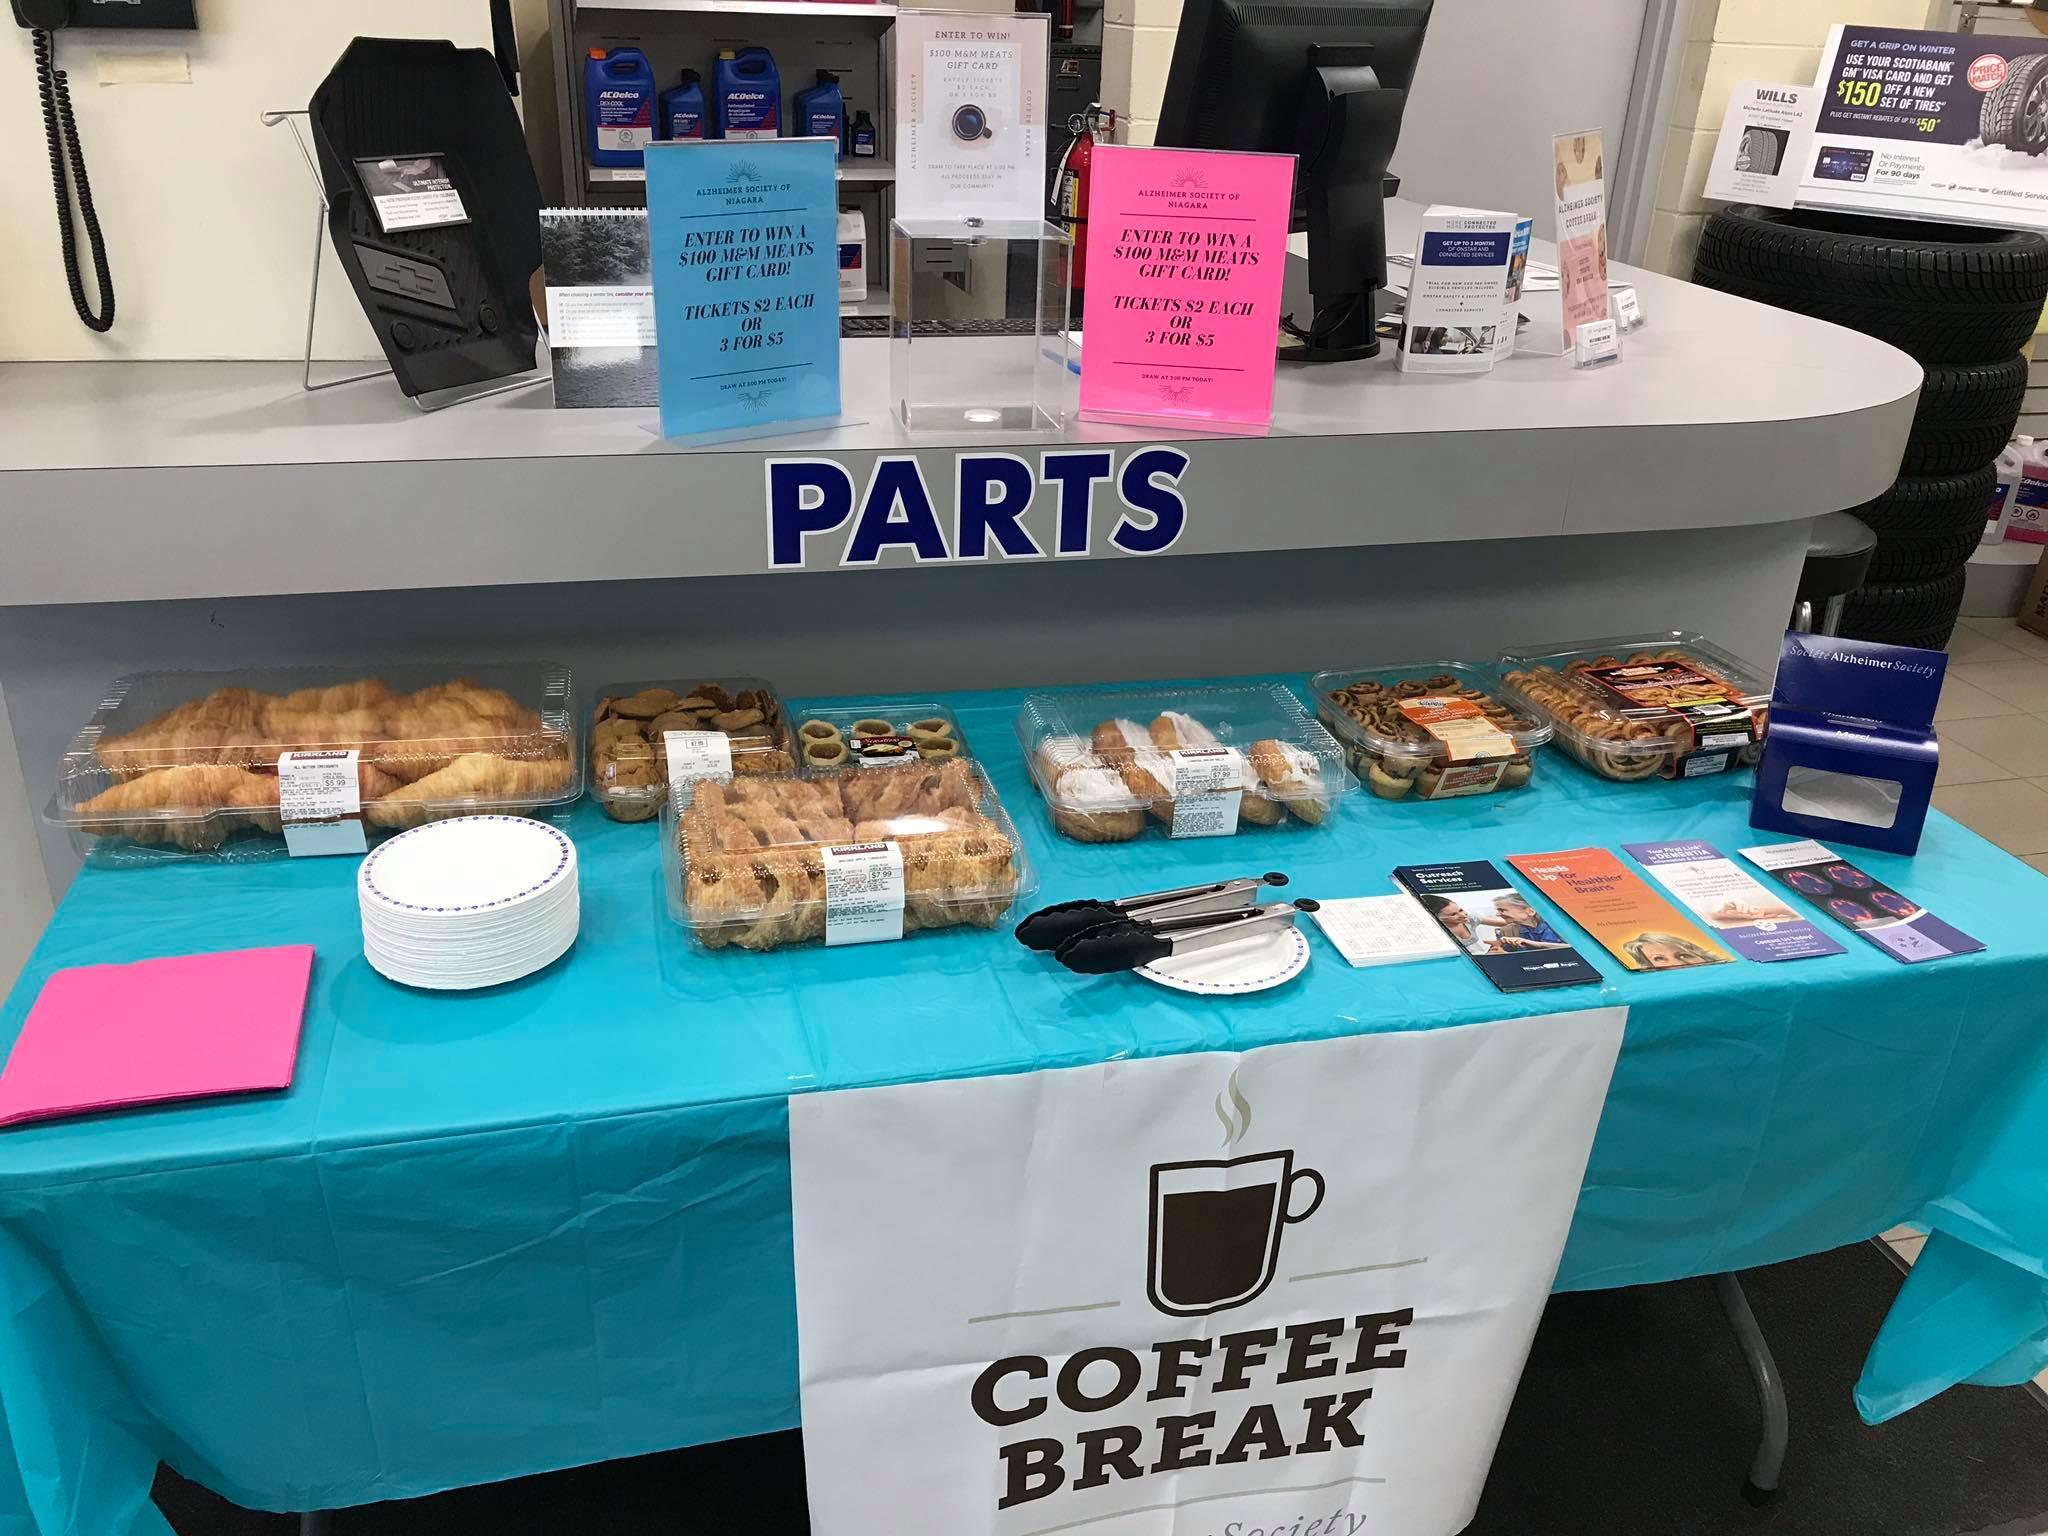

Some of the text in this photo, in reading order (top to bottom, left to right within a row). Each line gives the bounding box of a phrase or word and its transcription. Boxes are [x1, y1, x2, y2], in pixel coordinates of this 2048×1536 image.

[935, 31, 1010, 40] ENTER TO WIN!
[929, 49, 1014, 59] $100 M&M MEATS
[1851, 40, 1869, 48] GET
[1878, 42, 1901, 50] GRIP
[1919, 45, 1956, 55] WINTER
[947, 61, 999, 70] GIFT CARD
[1846, 54, 1865, 65] USE
[1866, 55, 1891, 67] YOUR
[1973, 63, 2003, 75] PRICE
[1886, 71, 1911, 82] CARD
[1912, 73, 1933, 84] AND
[1934, 75, 1954, 86] GET
[1973, 72, 2003, 83] MATCH
[600, 91, 639, 99] ACDelco
[1756, 89, 1798, 104] WILLS
[1837, 79, 1936, 107] $150 OFF A NEW
[1880, 97, 1898, 108] SET
[1899, 99, 1912, 110] OF
[1872, 114, 1893, 122] REBATES
[1893, 154, 1920, 162] Interest
[1890, 162, 1925, 172] Payments
[1903, 170, 1921, 179] days
[697, 187, 743, 196] ALZHEIMER
[745, 185, 777, 193] SOCIETY
[1138, 190, 1241, 201] ALZHEIMER SOCIETY OF
[1992, 188, 2048, 200] Certified Service
[726, 197, 763, 205] NIAGARA
[1168, 201, 1208, 209] NIAGARA
[684, 224, 806, 247] ENTER TO WIN A
[1121, 229, 1252, 248] ENTER TO WIN A
[678, 242, 815, 267] $100 M&M MEATS
[1114, 245, 1260, 265] $100 M&M MEATS
[706, 262, 791, 282] GIFT CARD!
[1139, 264, 1232, 281] GIFT CARD!
[685, 293, 815, 320] TICKETS $2 EACH
[1113, 295, 1255, 316] TICKETS $2 EACH
[741, 317, 762, 332] OR
[1170, 315, 1192, 329] OR
[719, 332, 784, 352] 3 FOR $5
[1145, 331, 1214, 348] 3 FOR $5
[764, 446, 1190, 569] PARTS
[1830, 652, 1936, 679] Alzheimer Society
[832, 843, 885, 852] KIRKLAND
[1656, 849, 1711, 860] DEMENTIA
[1529, 865, 1569, 874] Heads
[1536, 872, 1576, 882] Up for
[1566, 874, 1622, 887] Healthier
[1574, 885, 1615, 894] Brains
[971, 1307, 1414, 1427] COFFEE
[998, 1388, 1373, 1511] BREAK
